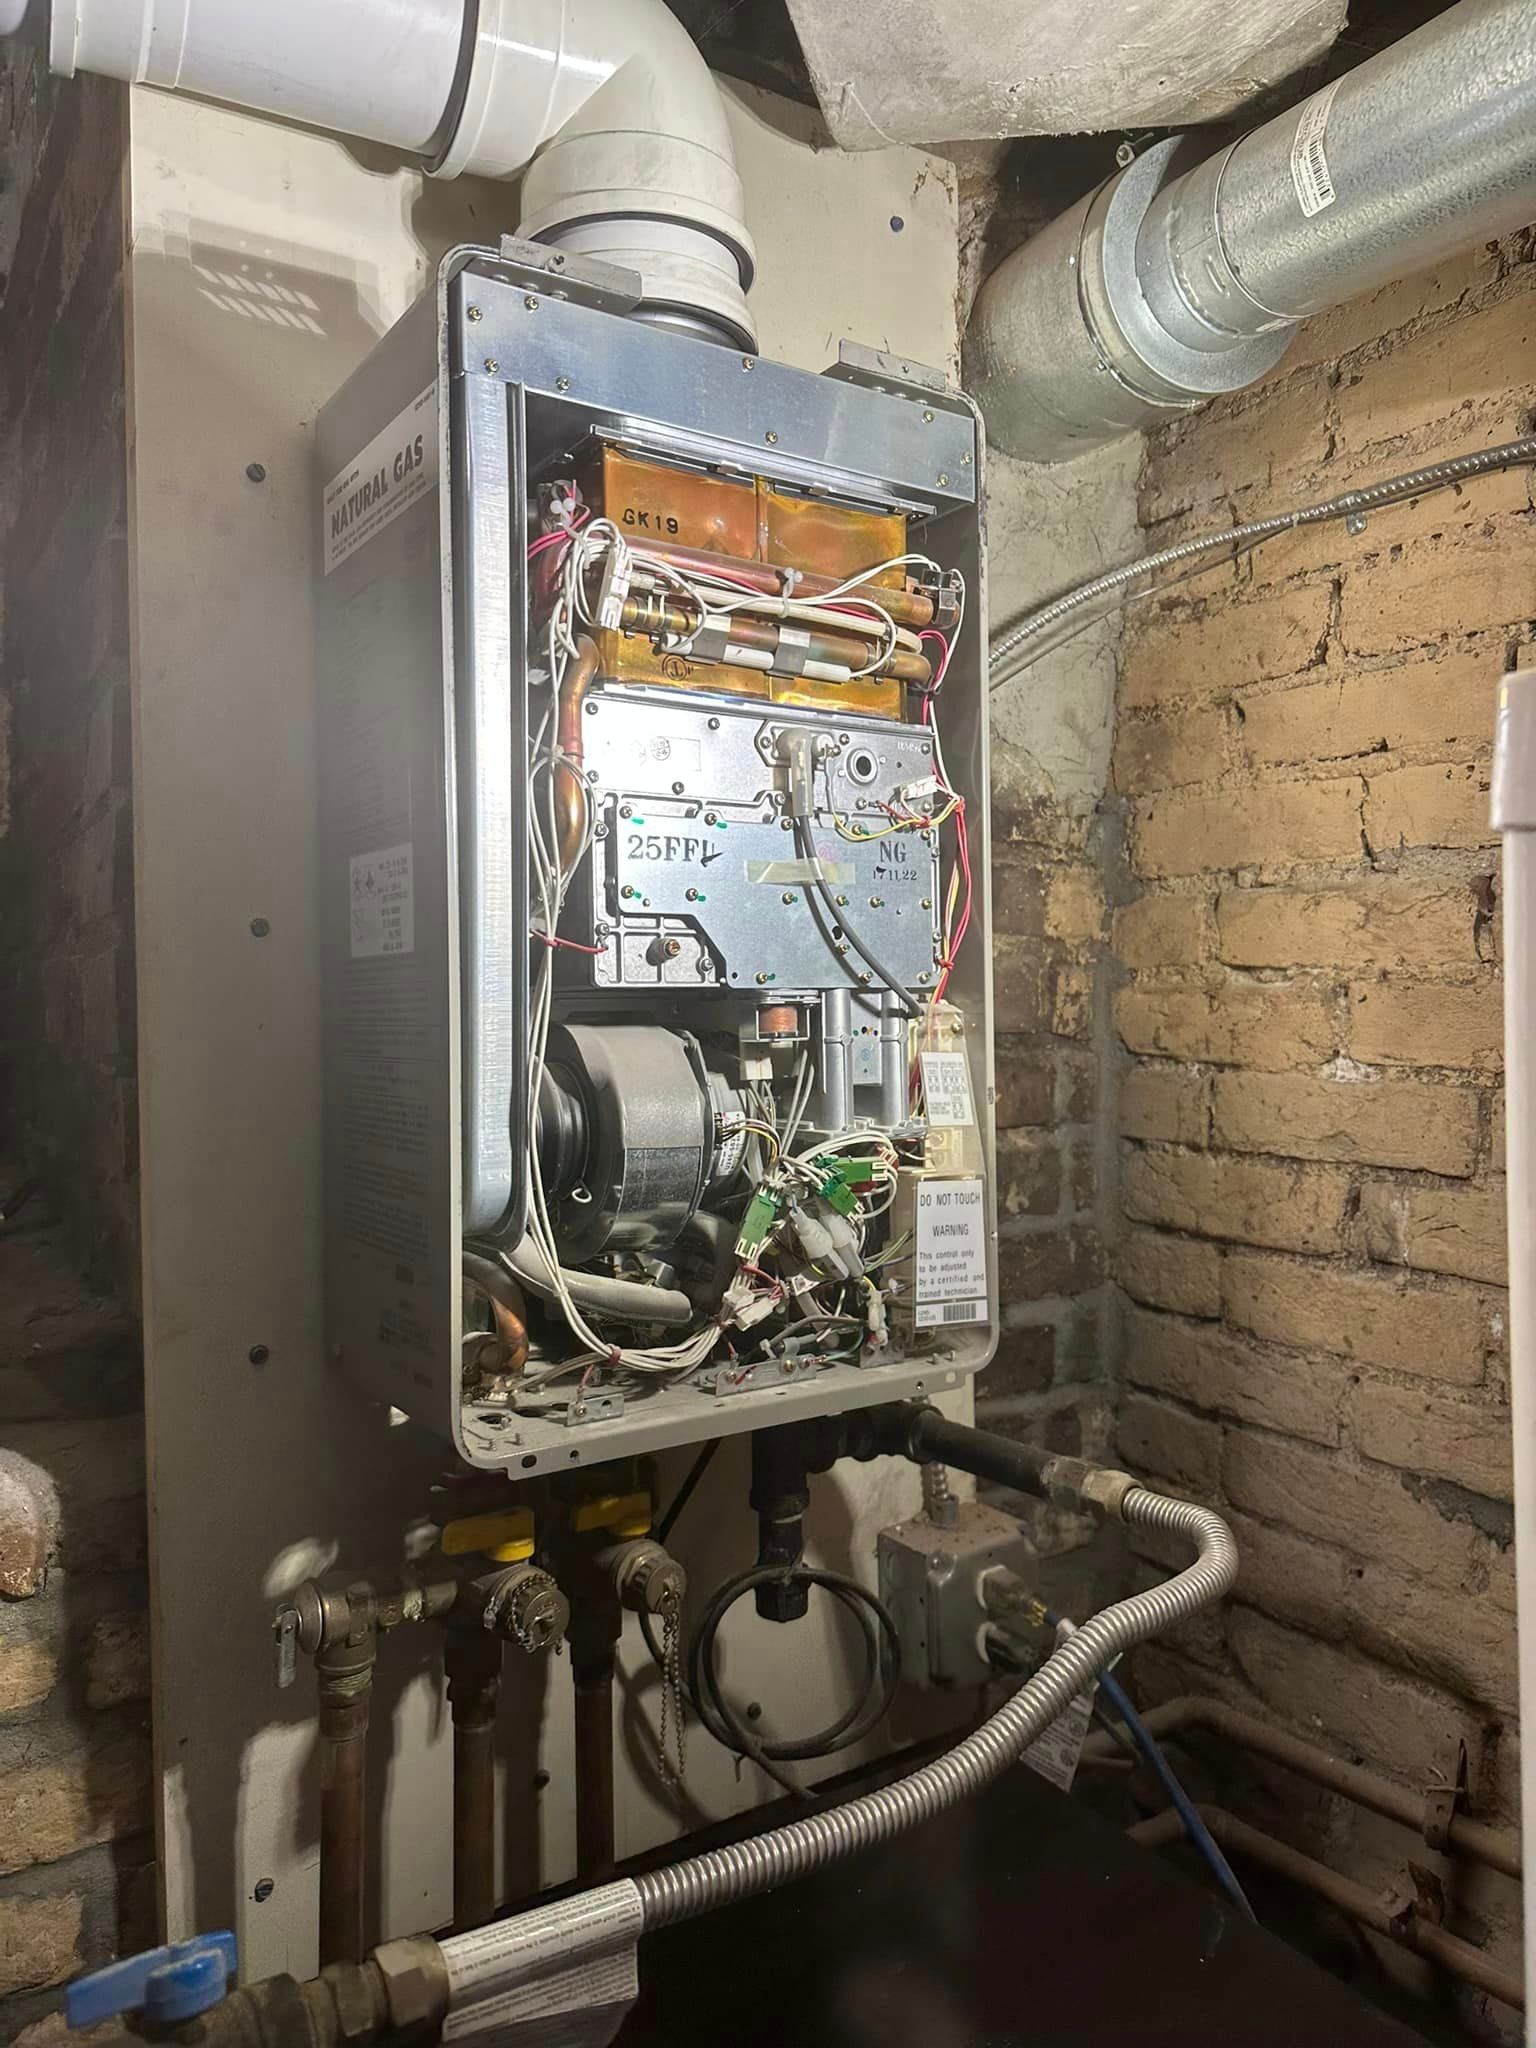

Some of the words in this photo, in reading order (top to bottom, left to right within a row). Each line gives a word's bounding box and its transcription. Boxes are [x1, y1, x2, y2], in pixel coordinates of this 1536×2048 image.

[331, 468, 389, 539] NATURAL
[393, 434, 423, 483] GAS
[880, 840, 906, 864] NG
[920, 1194, 932, 1207] DO
[937, 1193, 951, 1205] NOT
[954, 1191, 980, 1205] TOUCH
[932, 1224, 969, 1237] WARNING
